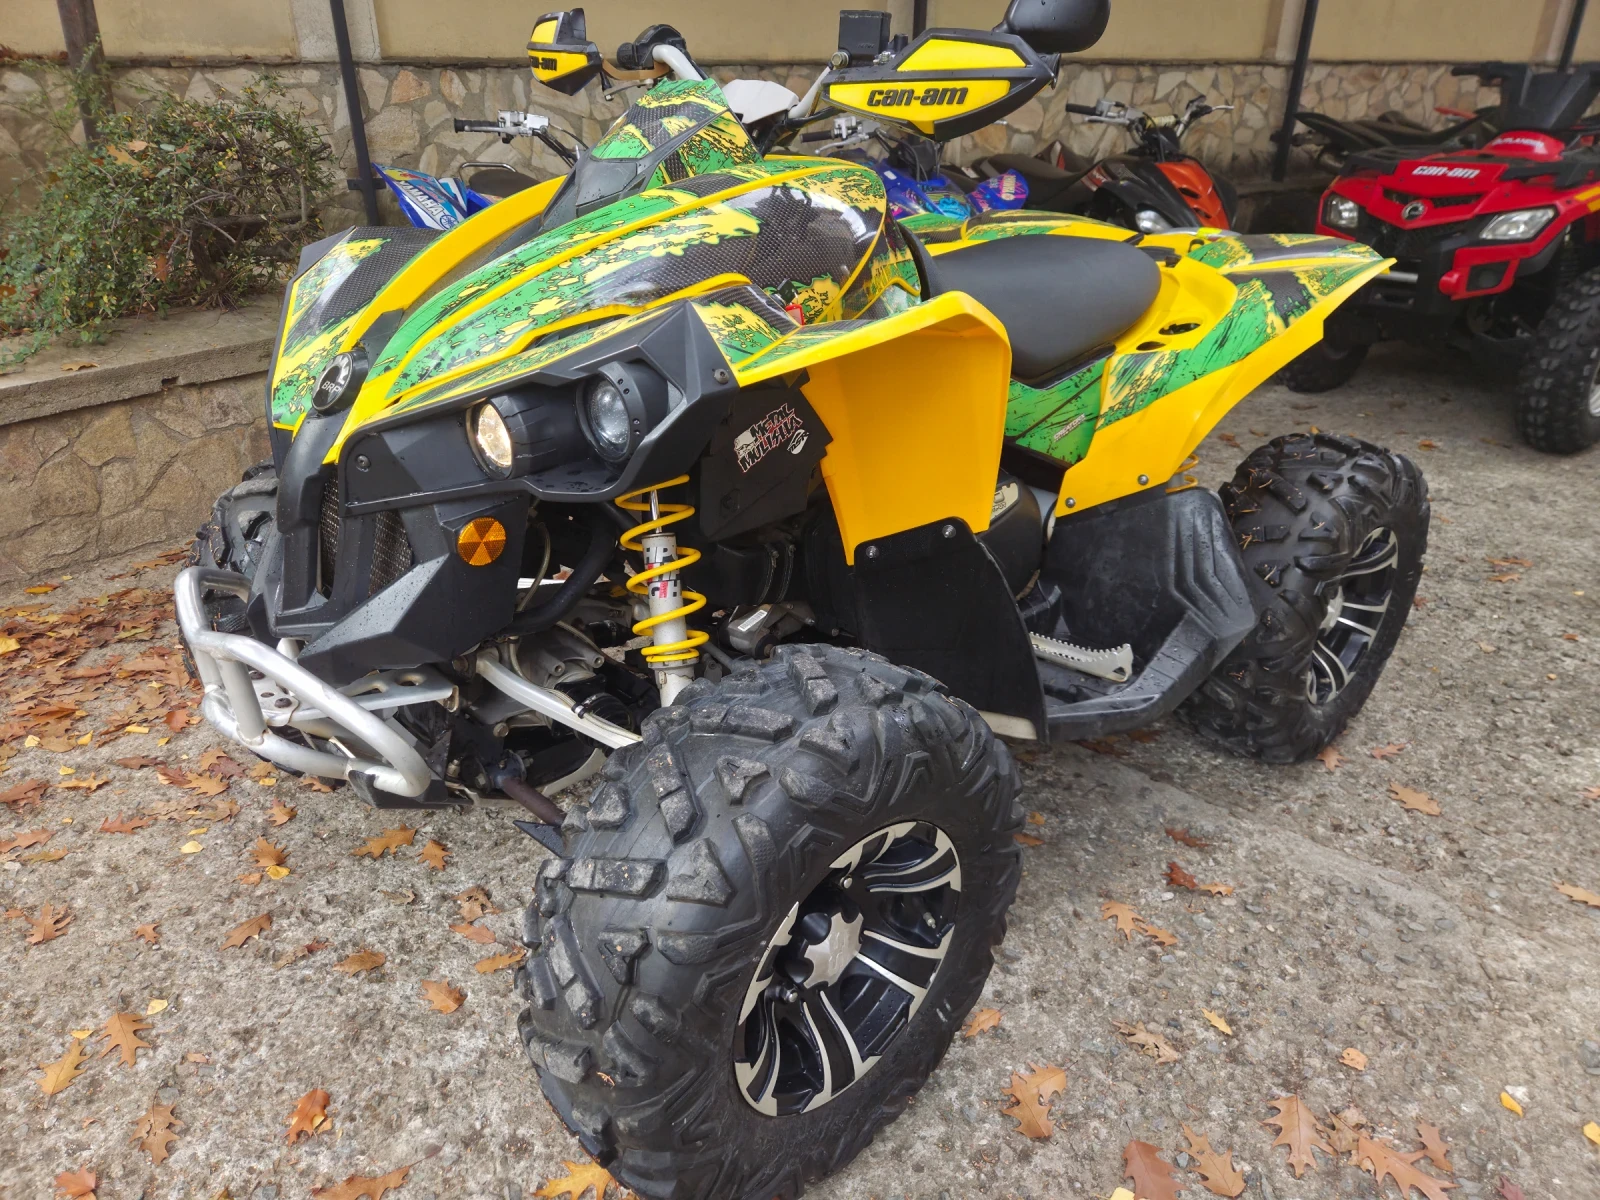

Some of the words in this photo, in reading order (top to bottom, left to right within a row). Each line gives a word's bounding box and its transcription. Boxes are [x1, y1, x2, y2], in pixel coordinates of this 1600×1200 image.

[867, 86, 968, 107] can-am
[1411, 165, 1480, 179] can-am
[399, 180, 444, 217] YAMAHA
[321, 380, 342, 393] BRP
